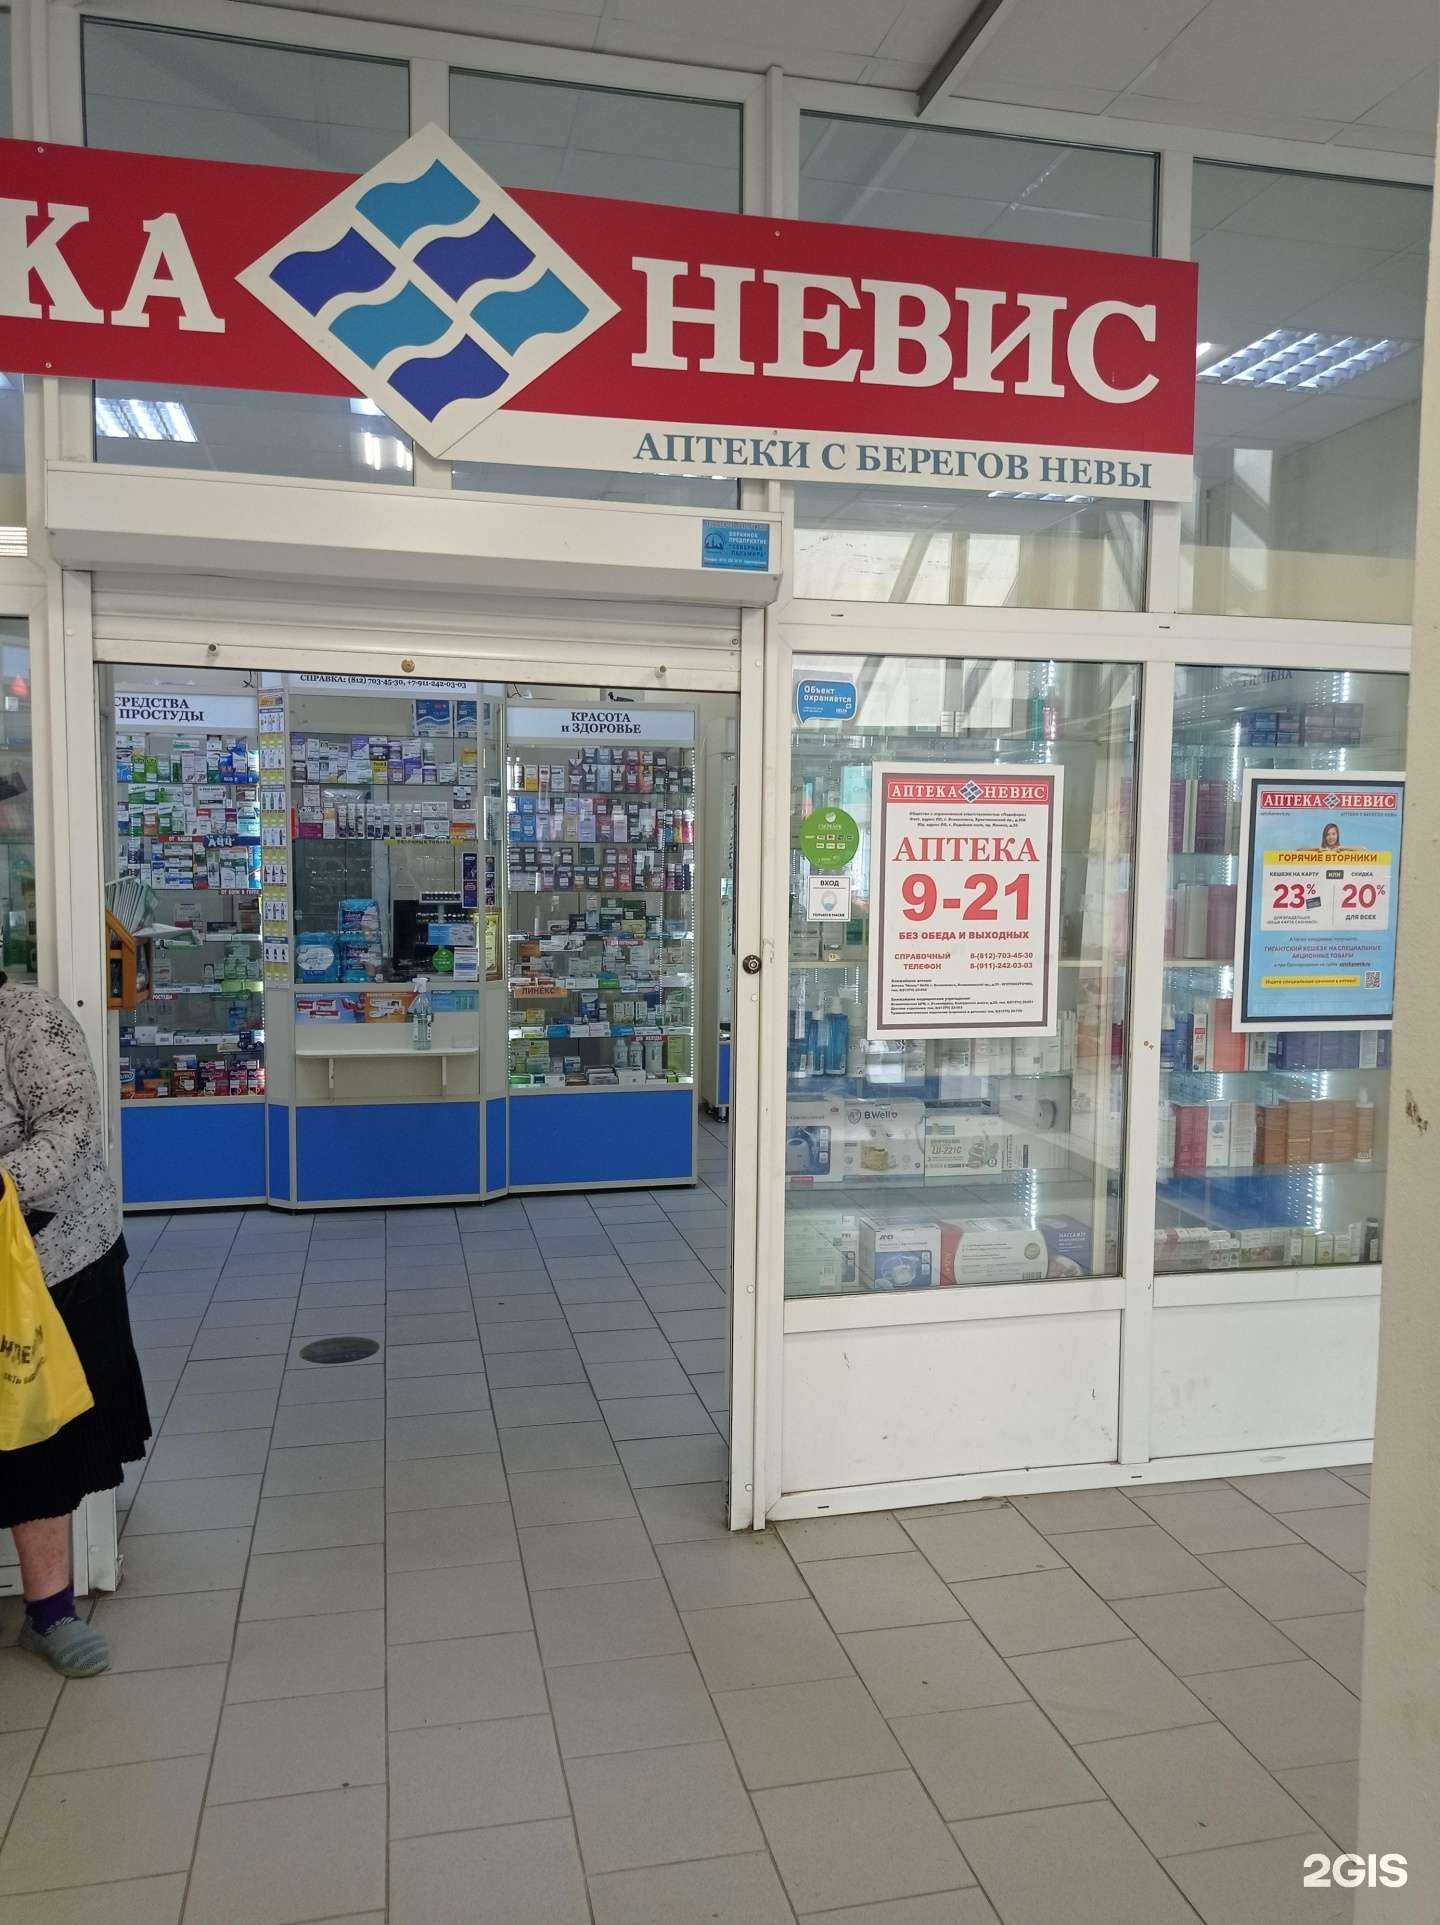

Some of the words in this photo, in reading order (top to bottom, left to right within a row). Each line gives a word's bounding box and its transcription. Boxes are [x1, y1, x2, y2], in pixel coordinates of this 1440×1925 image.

[631, 256, 1160, 404] НЕВИС
[633, 432, 809, 470] АПТЕКИ
[821, 442, 847, 471] С
[856, 443, 1030, 480] БЕРЕГОВ
[1039, 456, 1152, 489] НЕВЫ
[300, 674, 347, 683] СПРАВКА:
[348, 676, 367, 685] (812)
[804, 685, 835, 694] Объект
[114, 696, 189, 709] СРЕДСТВА
[803, 694, 852, 703] охраняется
[119, 708, 205, 722] ПРОСТУДЫ
[571, 711, 632, 722] КРАСОТА
[561, 725, 570, 733] и
[572, 722, 642, 734] ЗДОРОВЬЕ
[891, 784, 958, 798] АПТЕКА
[984, 785, 1046, 800] НЕВИС
[1263, 794, 1322, 807] АПТЕКА
[1341, 794, 1395, 807] НЕВИС
[891, 836, 1040, 862] АПТЕКА
[1278, 854, 1323, 862] ГОРЯЧИЕ
[1325, 854, 1377, 862] ВТОРНИКИ
[901, 873, 1030, 922] 9-21
[899, 931, 918, 940] БЕЗ
[921, 931, 956, 940] ОБЕДА
[958, 931, 966, 940] И
[969, 931, 1030, 940] ВЫХОДНЫХ
[894, 952, 951, 960] СПРАВОЧНЫЙ
[970, 952, 1034, 960] 8-(812)-703-45-30
[904, 962, 942, 970] ТЕЛЕФОН
[970, 962, 1033, 970] 8-(911)-242-03-03
